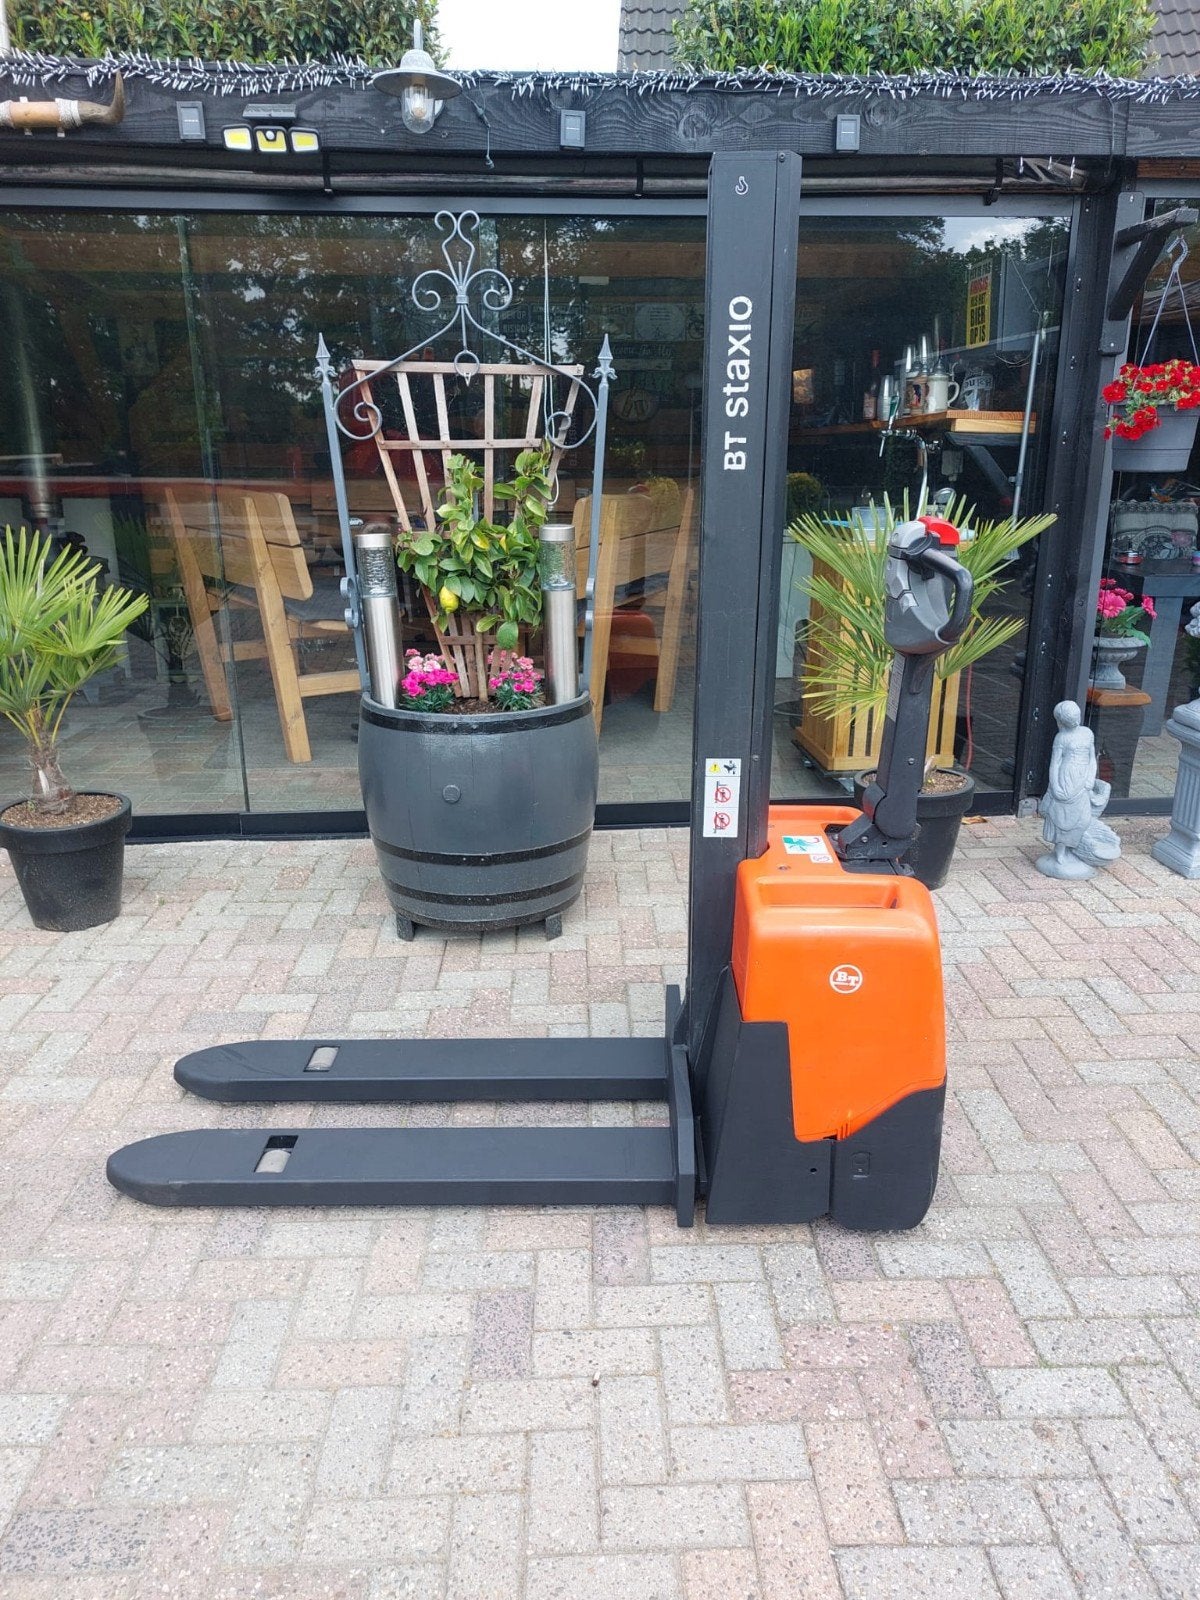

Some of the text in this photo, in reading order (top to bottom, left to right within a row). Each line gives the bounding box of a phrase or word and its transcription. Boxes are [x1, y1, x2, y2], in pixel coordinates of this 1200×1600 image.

[970, 305, 986, 328] BIER
[970, 324, 986, 345] OP IS
[723, 430, 747, 471] BT
